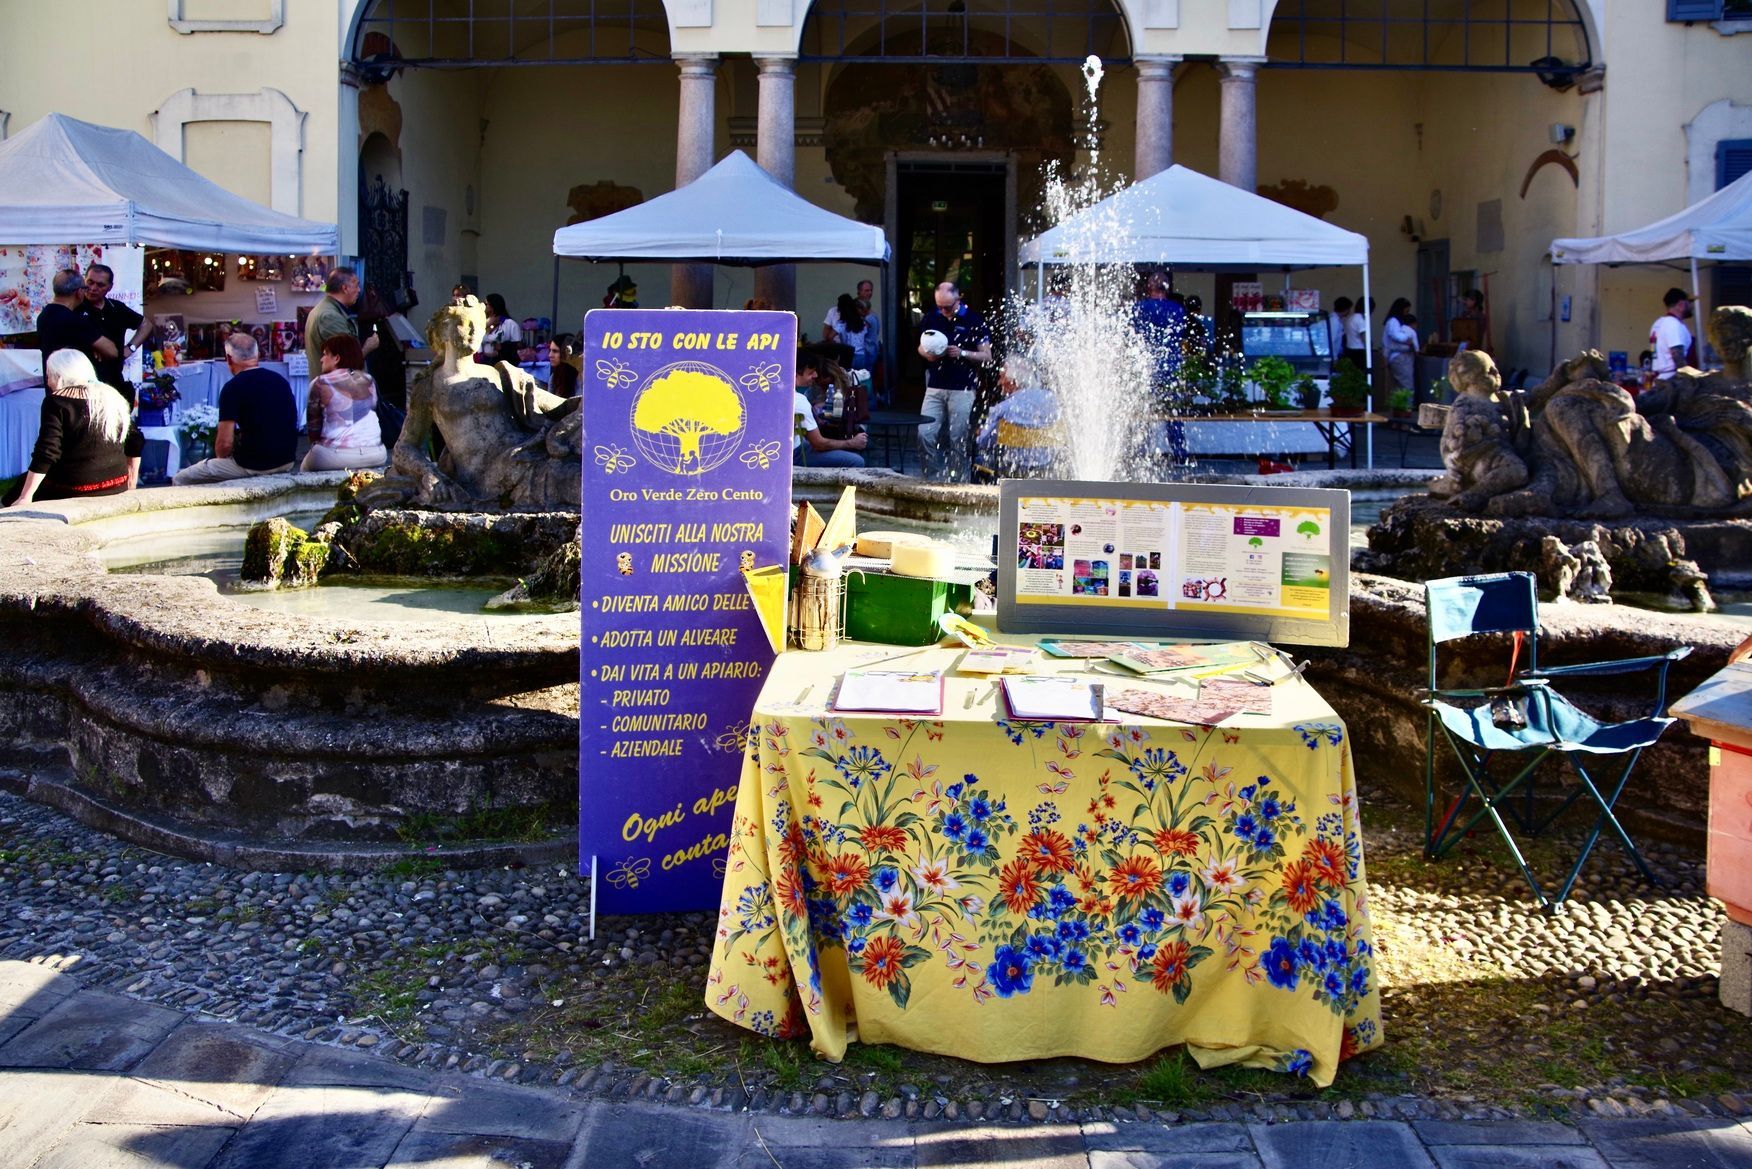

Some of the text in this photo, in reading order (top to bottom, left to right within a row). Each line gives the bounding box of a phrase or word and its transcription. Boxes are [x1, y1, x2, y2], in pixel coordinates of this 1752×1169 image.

[602, 332, 780, 350] IO STO CON LE API
[610, 489, 638, 501] Oro
[641, 488, 683, 501] Verde
[722, 488, 763, 500] Cento
[610, 522, 764, 544] UNISCITI ALLA NOSTRA
[651, 553, 721, 573] MISSIONE
[601, 595, 659, 613] DIVENTA
[662, 594, 710, 612] AMICO
[713, 594, 750, 611] DELLE
[600, 628, 738, 648] ADOTTA UN ALVEARE
[601, 661, 762, 682] DAI VITA A UN APIARIO:
[612, 689, 670, 707] PRIVATO
[612, 714, 708, 732] COMUNITARIO
[610, 738, 684, 758] AZIENDALE
[622, 784, 738, 843] Ogni ape
[661, 832, 730, 871] conta
